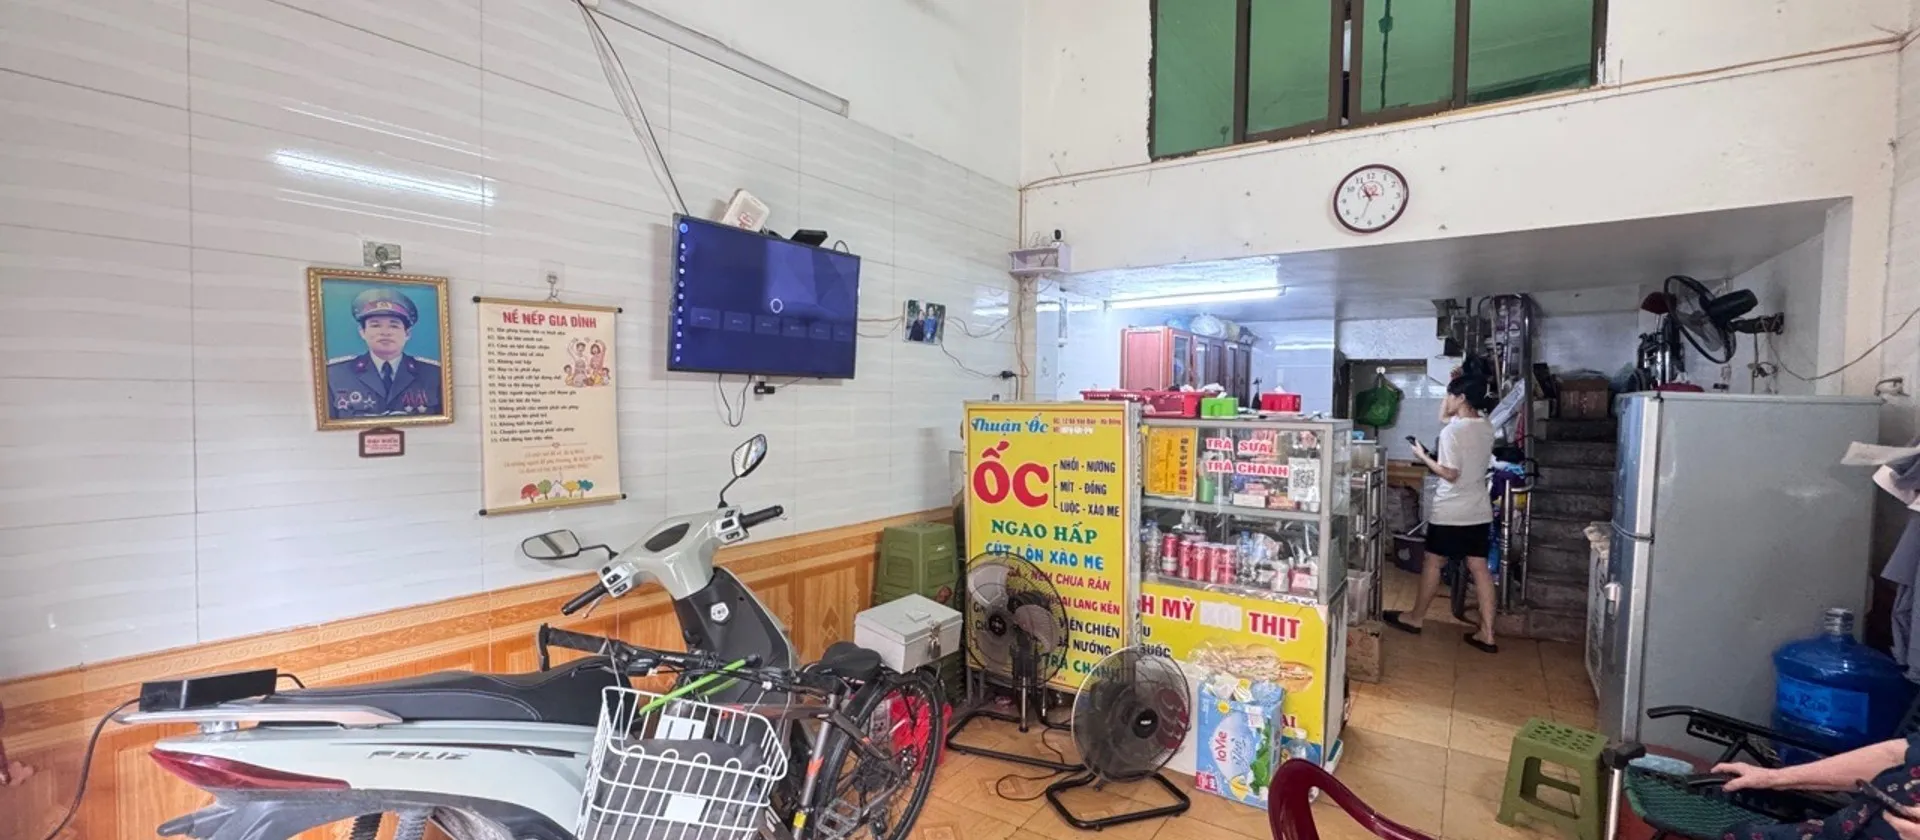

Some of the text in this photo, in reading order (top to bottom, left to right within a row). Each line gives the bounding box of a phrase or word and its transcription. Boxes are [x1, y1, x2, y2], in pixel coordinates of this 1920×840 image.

[549, 315, 568, 327] GIA
[974, 440, 1050, 508] ỐC
[1238, 463, 1288, 476] CHANH
[1107, 505, 1120, 517] ME
[991, 519, 1098, 544] NGAO HẤP
[1084, 554, 1104, 570] ME
[1056, 573, 1084, 587] CHUA
[1073, 598, 1098, 612] LANG
[1248, 612, 1301, 642] THỊT
[367, 750, 470, 761] FELIZ
